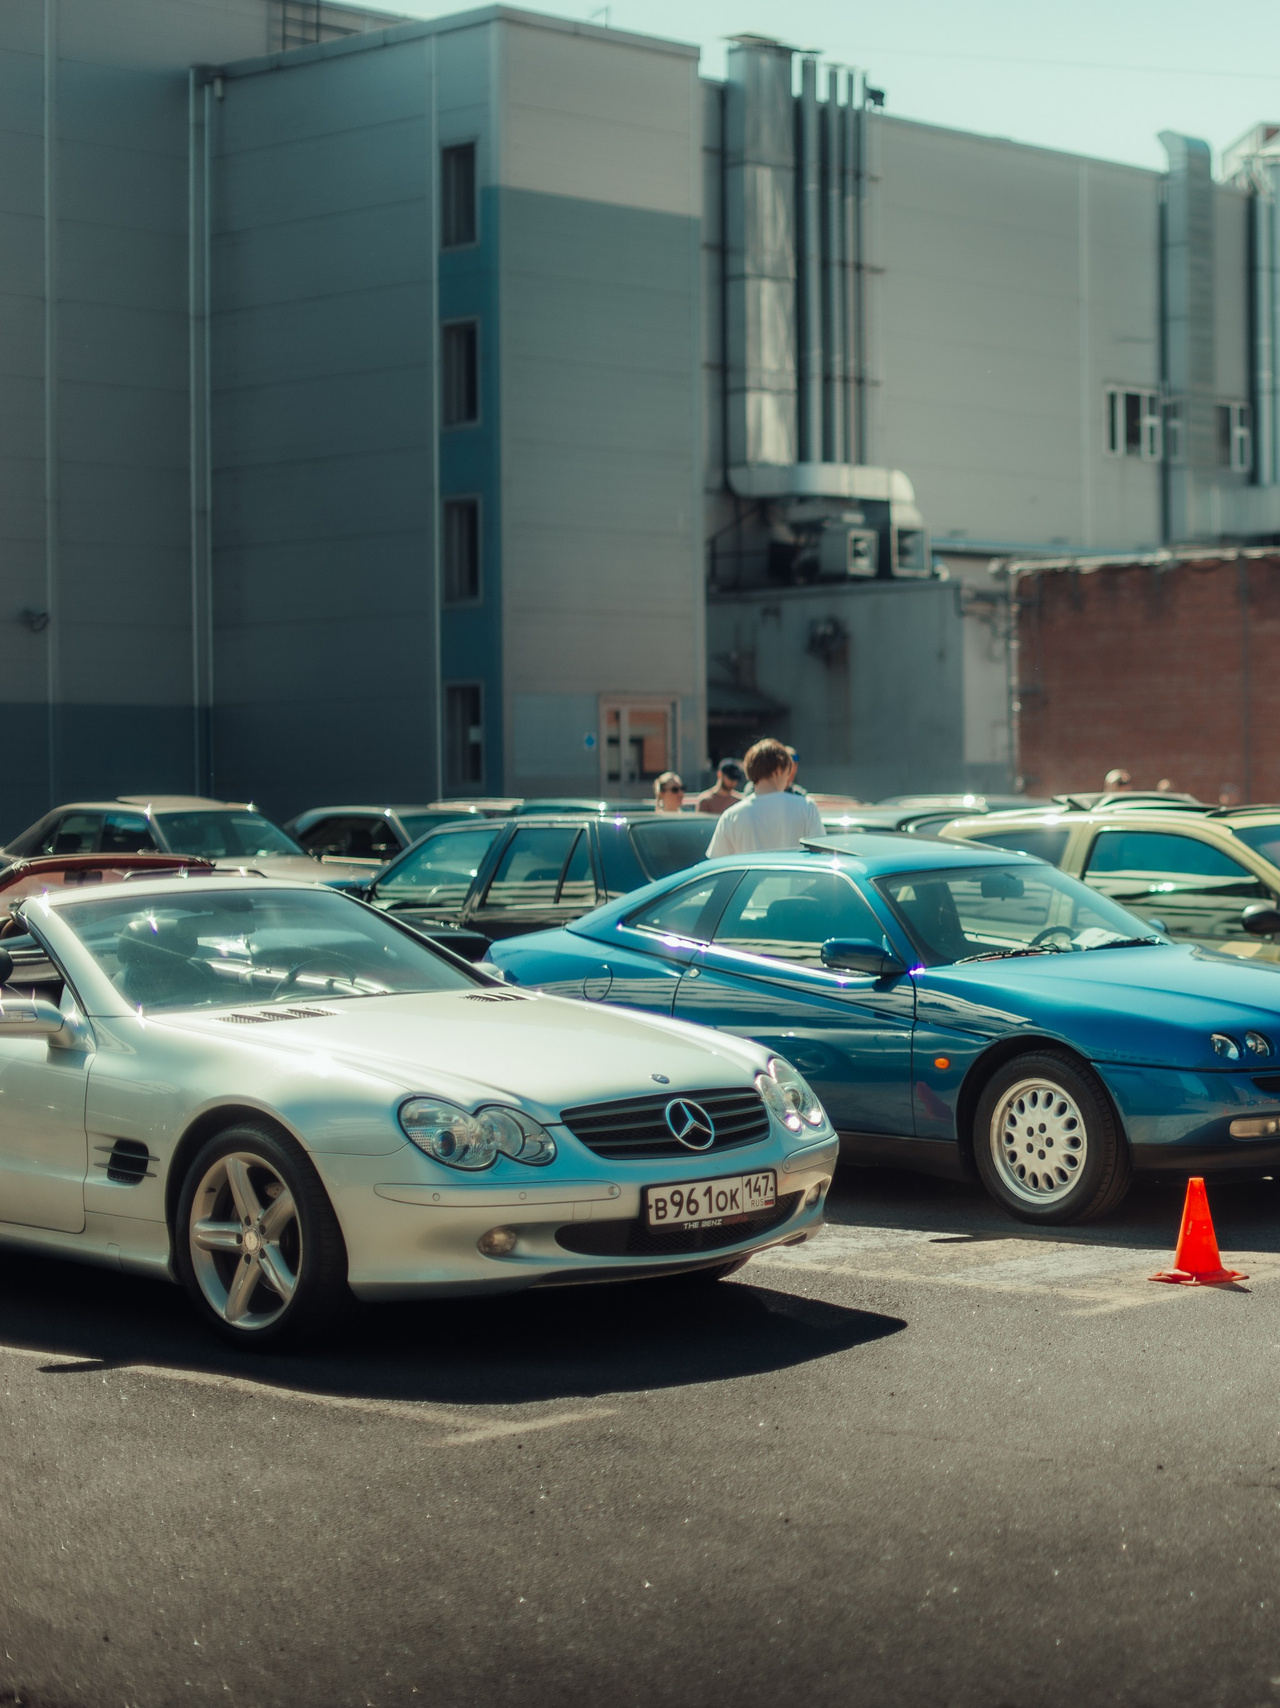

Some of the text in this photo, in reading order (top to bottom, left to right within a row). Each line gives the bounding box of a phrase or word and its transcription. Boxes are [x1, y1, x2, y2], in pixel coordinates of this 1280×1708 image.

[745, 1175, 770, 1199] 147
[751, 1198, 764, 1207] RUS
[683, 1221, 699, 1230] THE
[701, 1218, 723, 1228] BENZ
